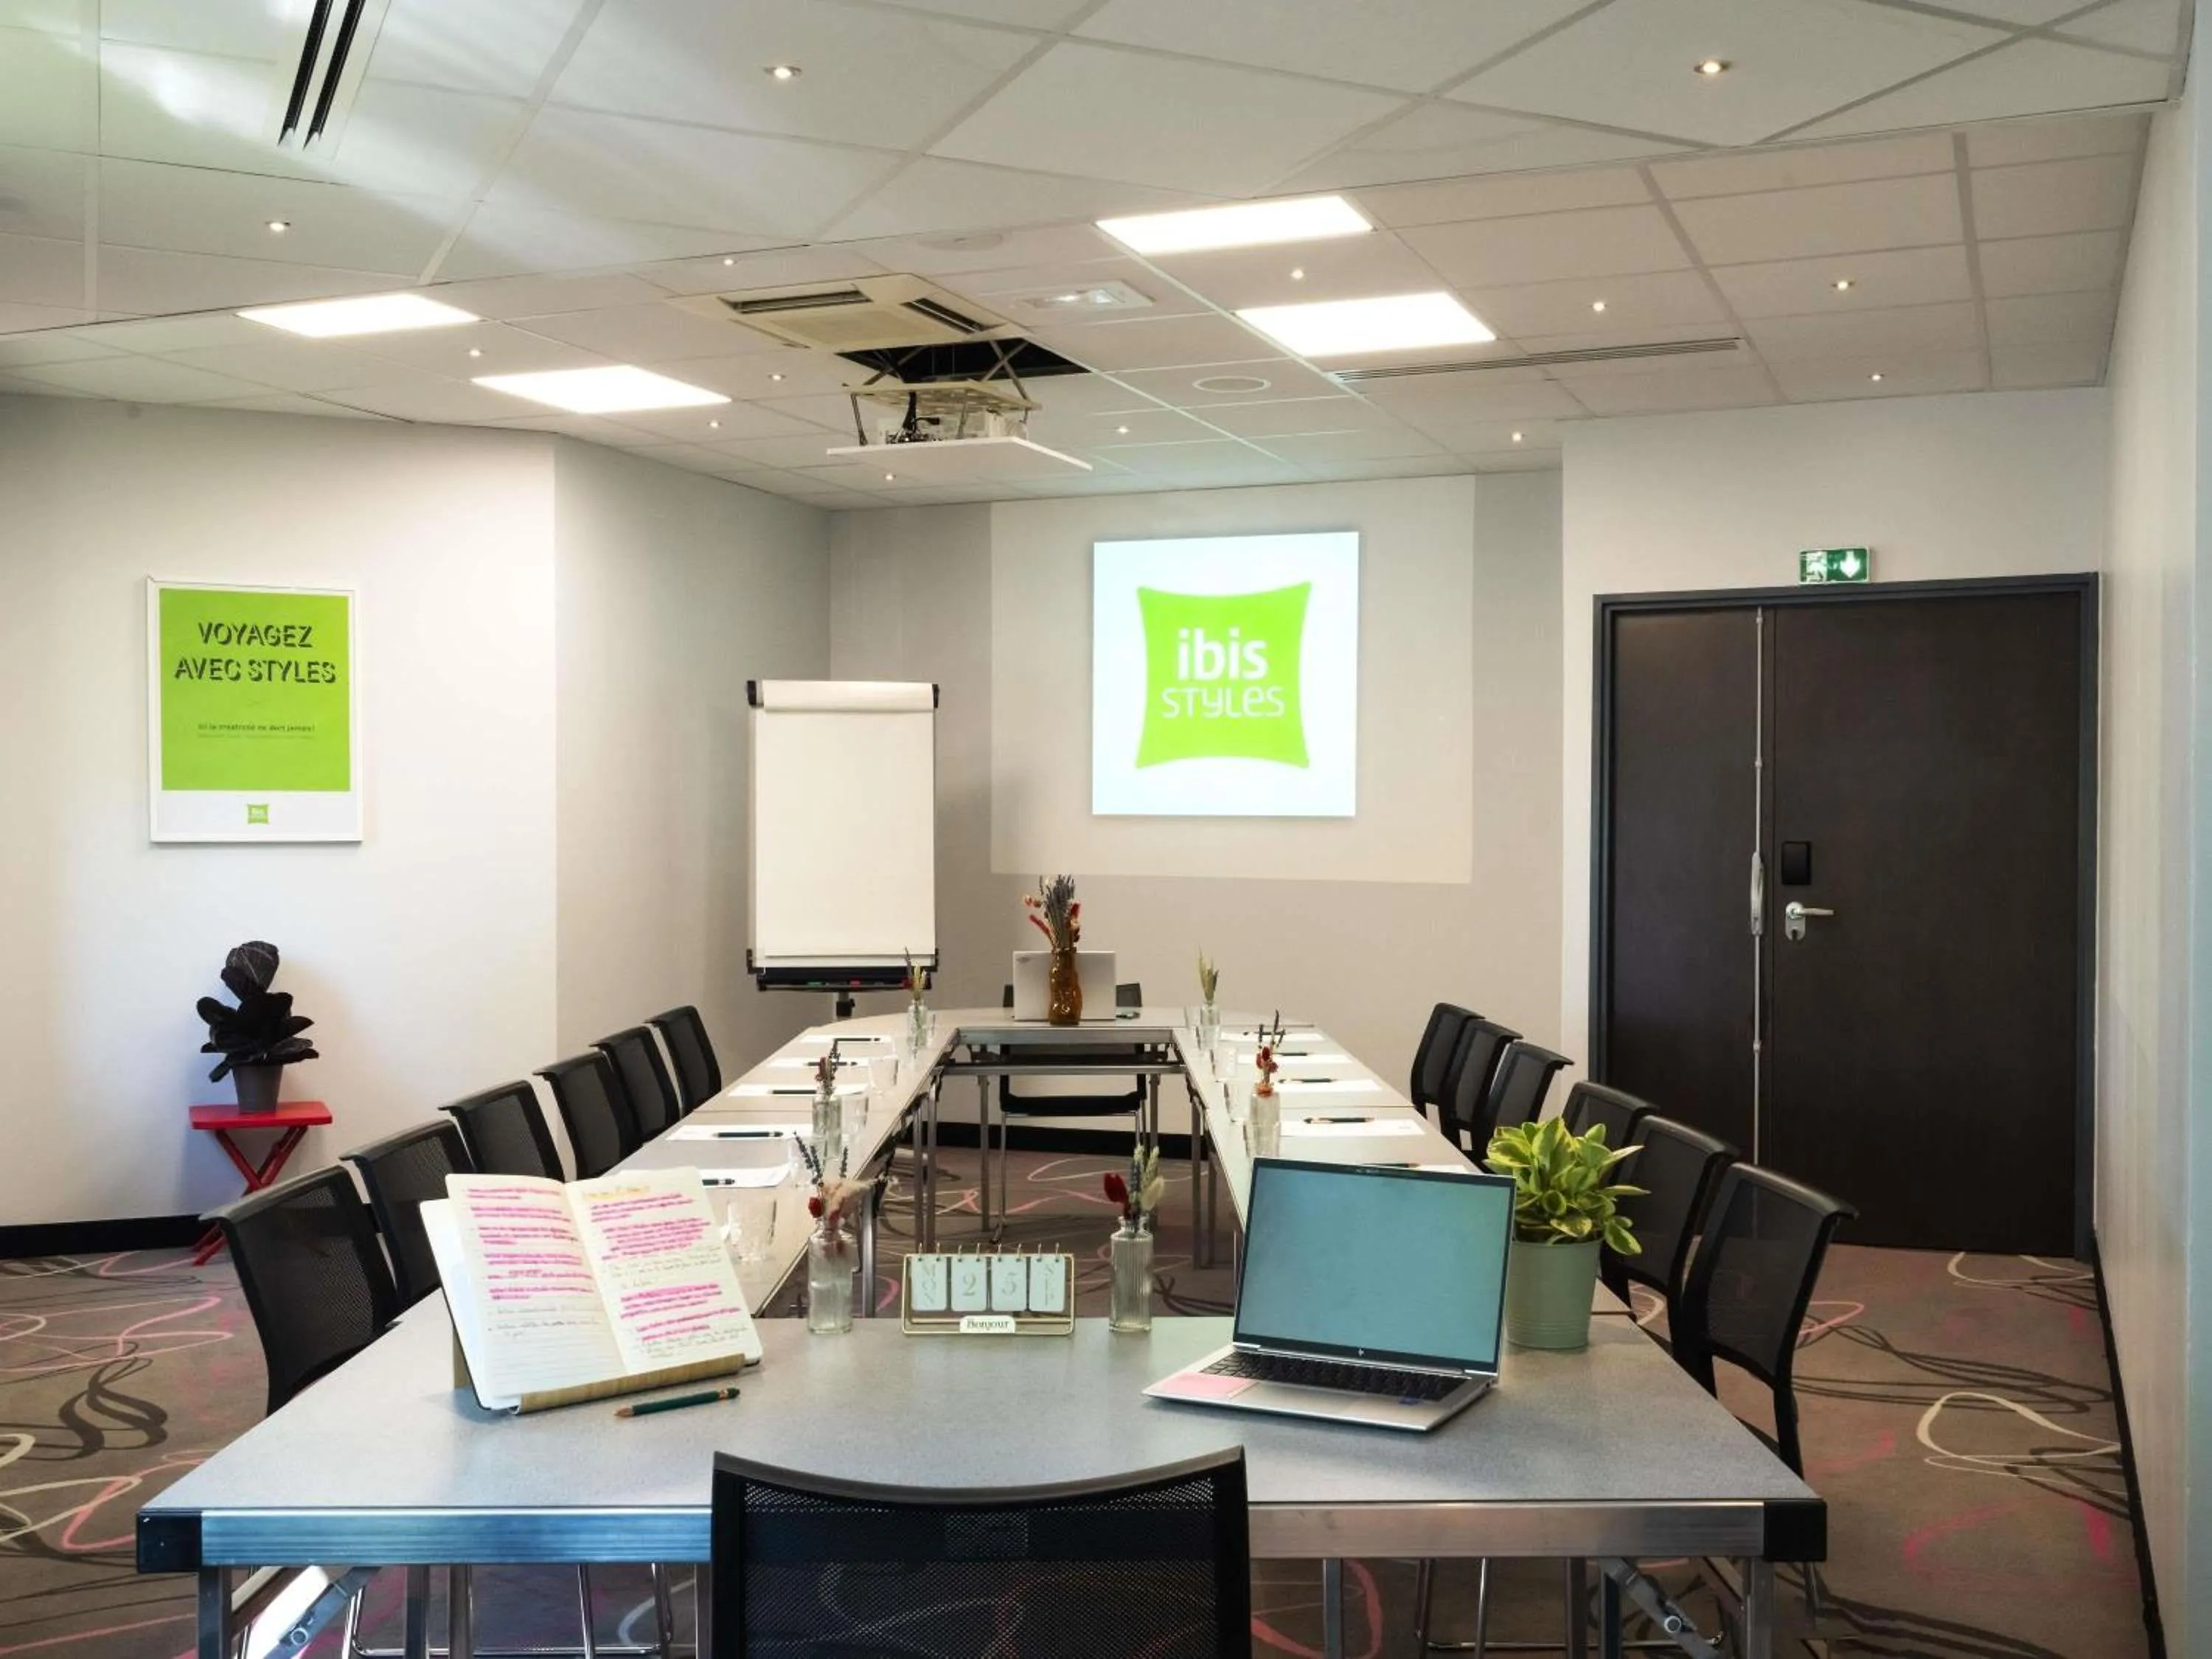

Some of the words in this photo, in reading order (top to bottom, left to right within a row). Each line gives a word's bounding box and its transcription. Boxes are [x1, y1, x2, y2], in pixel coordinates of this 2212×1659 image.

[198, 622, 313, 647] VOYAGEZ
[1177, 627, 1270, 681] ibis
[175, 657, 242, 681] AVEC
[248, 659, 336, 684] STYLES
